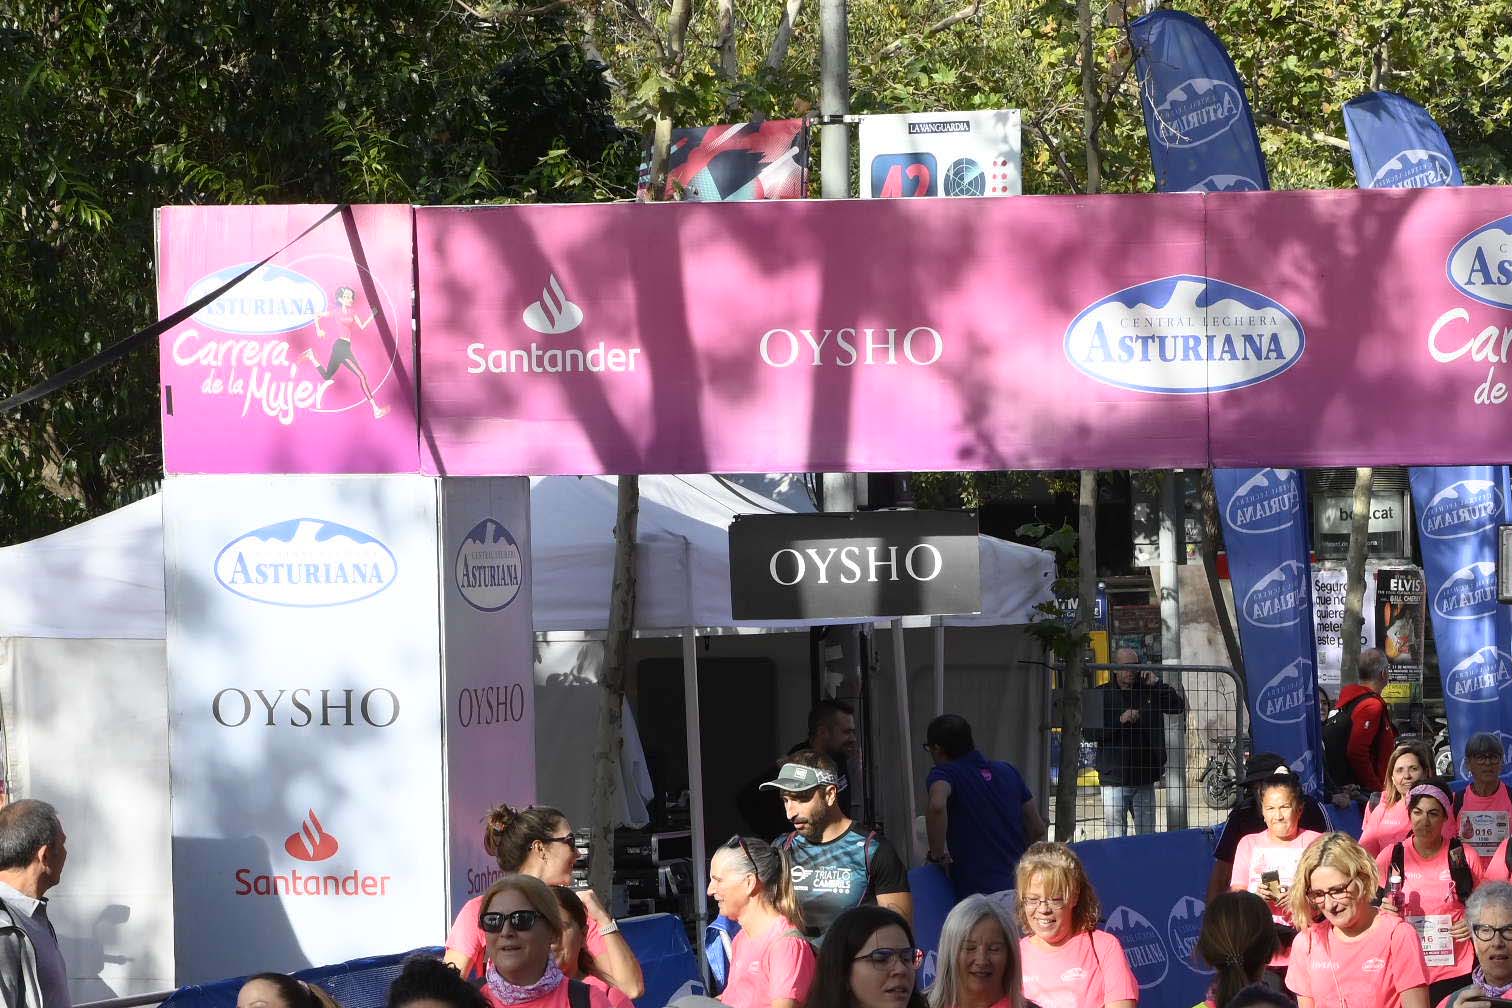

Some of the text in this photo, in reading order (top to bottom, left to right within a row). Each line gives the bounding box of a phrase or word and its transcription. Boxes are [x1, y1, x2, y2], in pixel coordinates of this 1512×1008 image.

[918, 121, 969, 133] VANGUARDIA
[1120, 316, 1195, 329] CENTRAL
[172, 331, 290, 368] Carrera
[467, 341, 641, 374] Santander
[759, 326, 943, 368] OYSHO
[1085, 321, 1287, 363] ASTURIANA
[201, 366, 334, 425] de la Mujer
[1474, 367, 1508, 405] de
[229, 552, 385, 586] ASTURIANA
[461, 556, 519, 591] ASTURIANA
[769, 543, 944, 586] OYSHO
[1315, 596, 1331, 606] que
[1390, 578, 1421, 591] ELVIS
[1318, 635, 1335, 646] este
[212, 687, 400, 728] OYSHO
[458, 682, 525, 727] OYSHO
[235, 867, 391, 896] Santander
